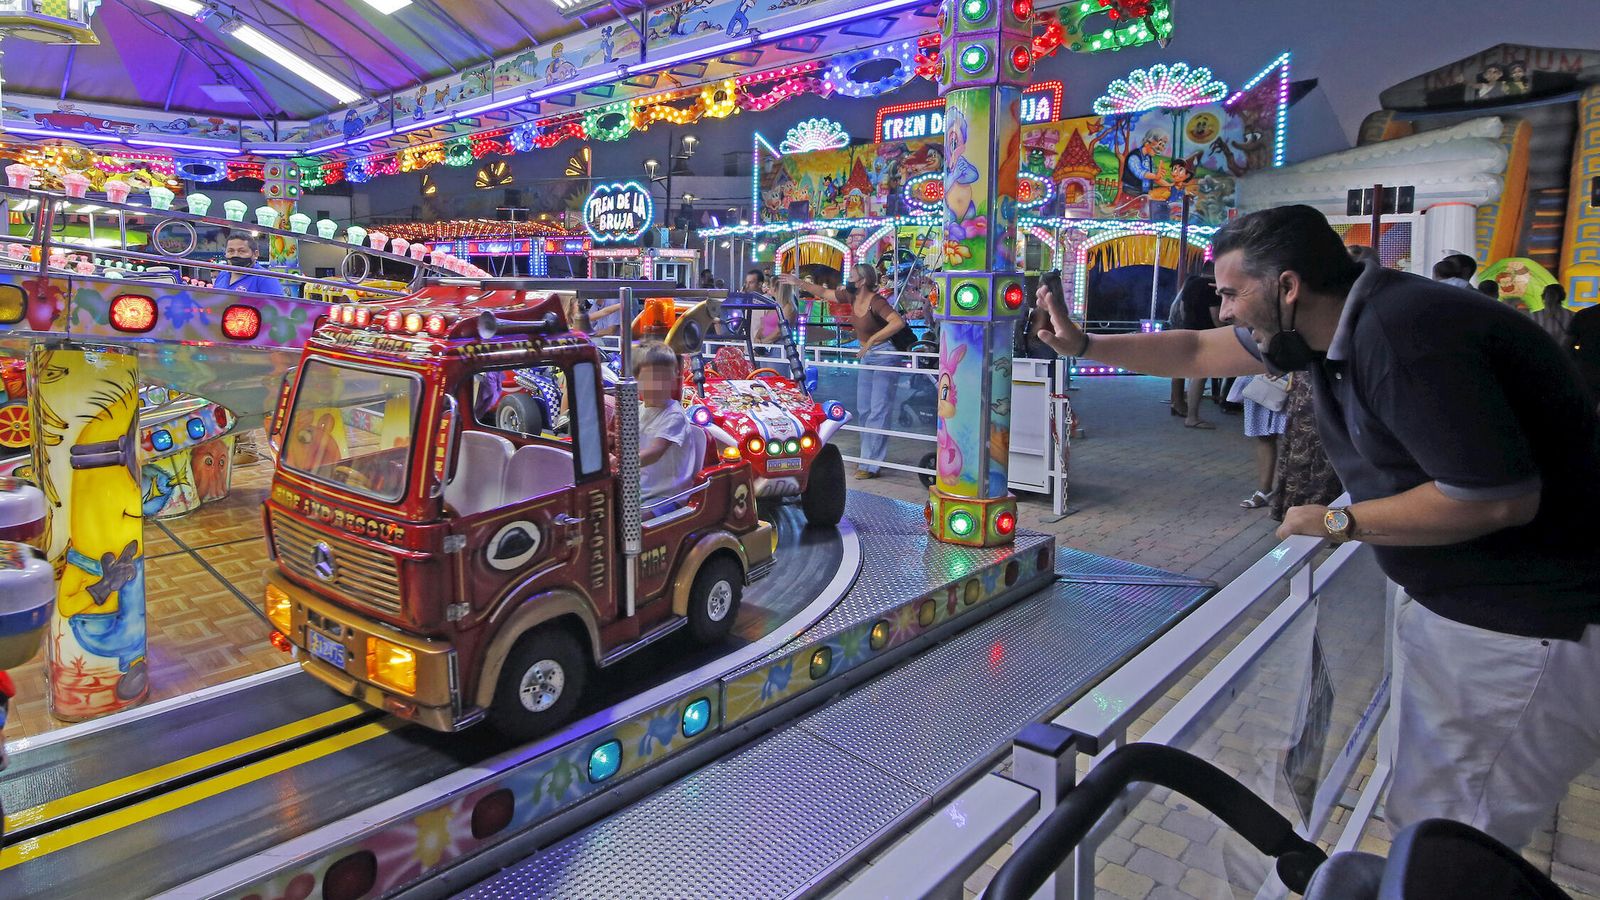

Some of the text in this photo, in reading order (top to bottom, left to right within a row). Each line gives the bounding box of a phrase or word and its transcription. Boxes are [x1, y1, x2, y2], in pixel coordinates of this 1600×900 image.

[883, 114, 926, 139] TREN
[931, 113, 946, 134] D
[590, 192, 646, 222] TREN DE LA
[600, 213, 634, 231] BRUJA
[275, 485, 405, 543] FIRE AND RESCUE
[733, 483, 749, 519] 3
